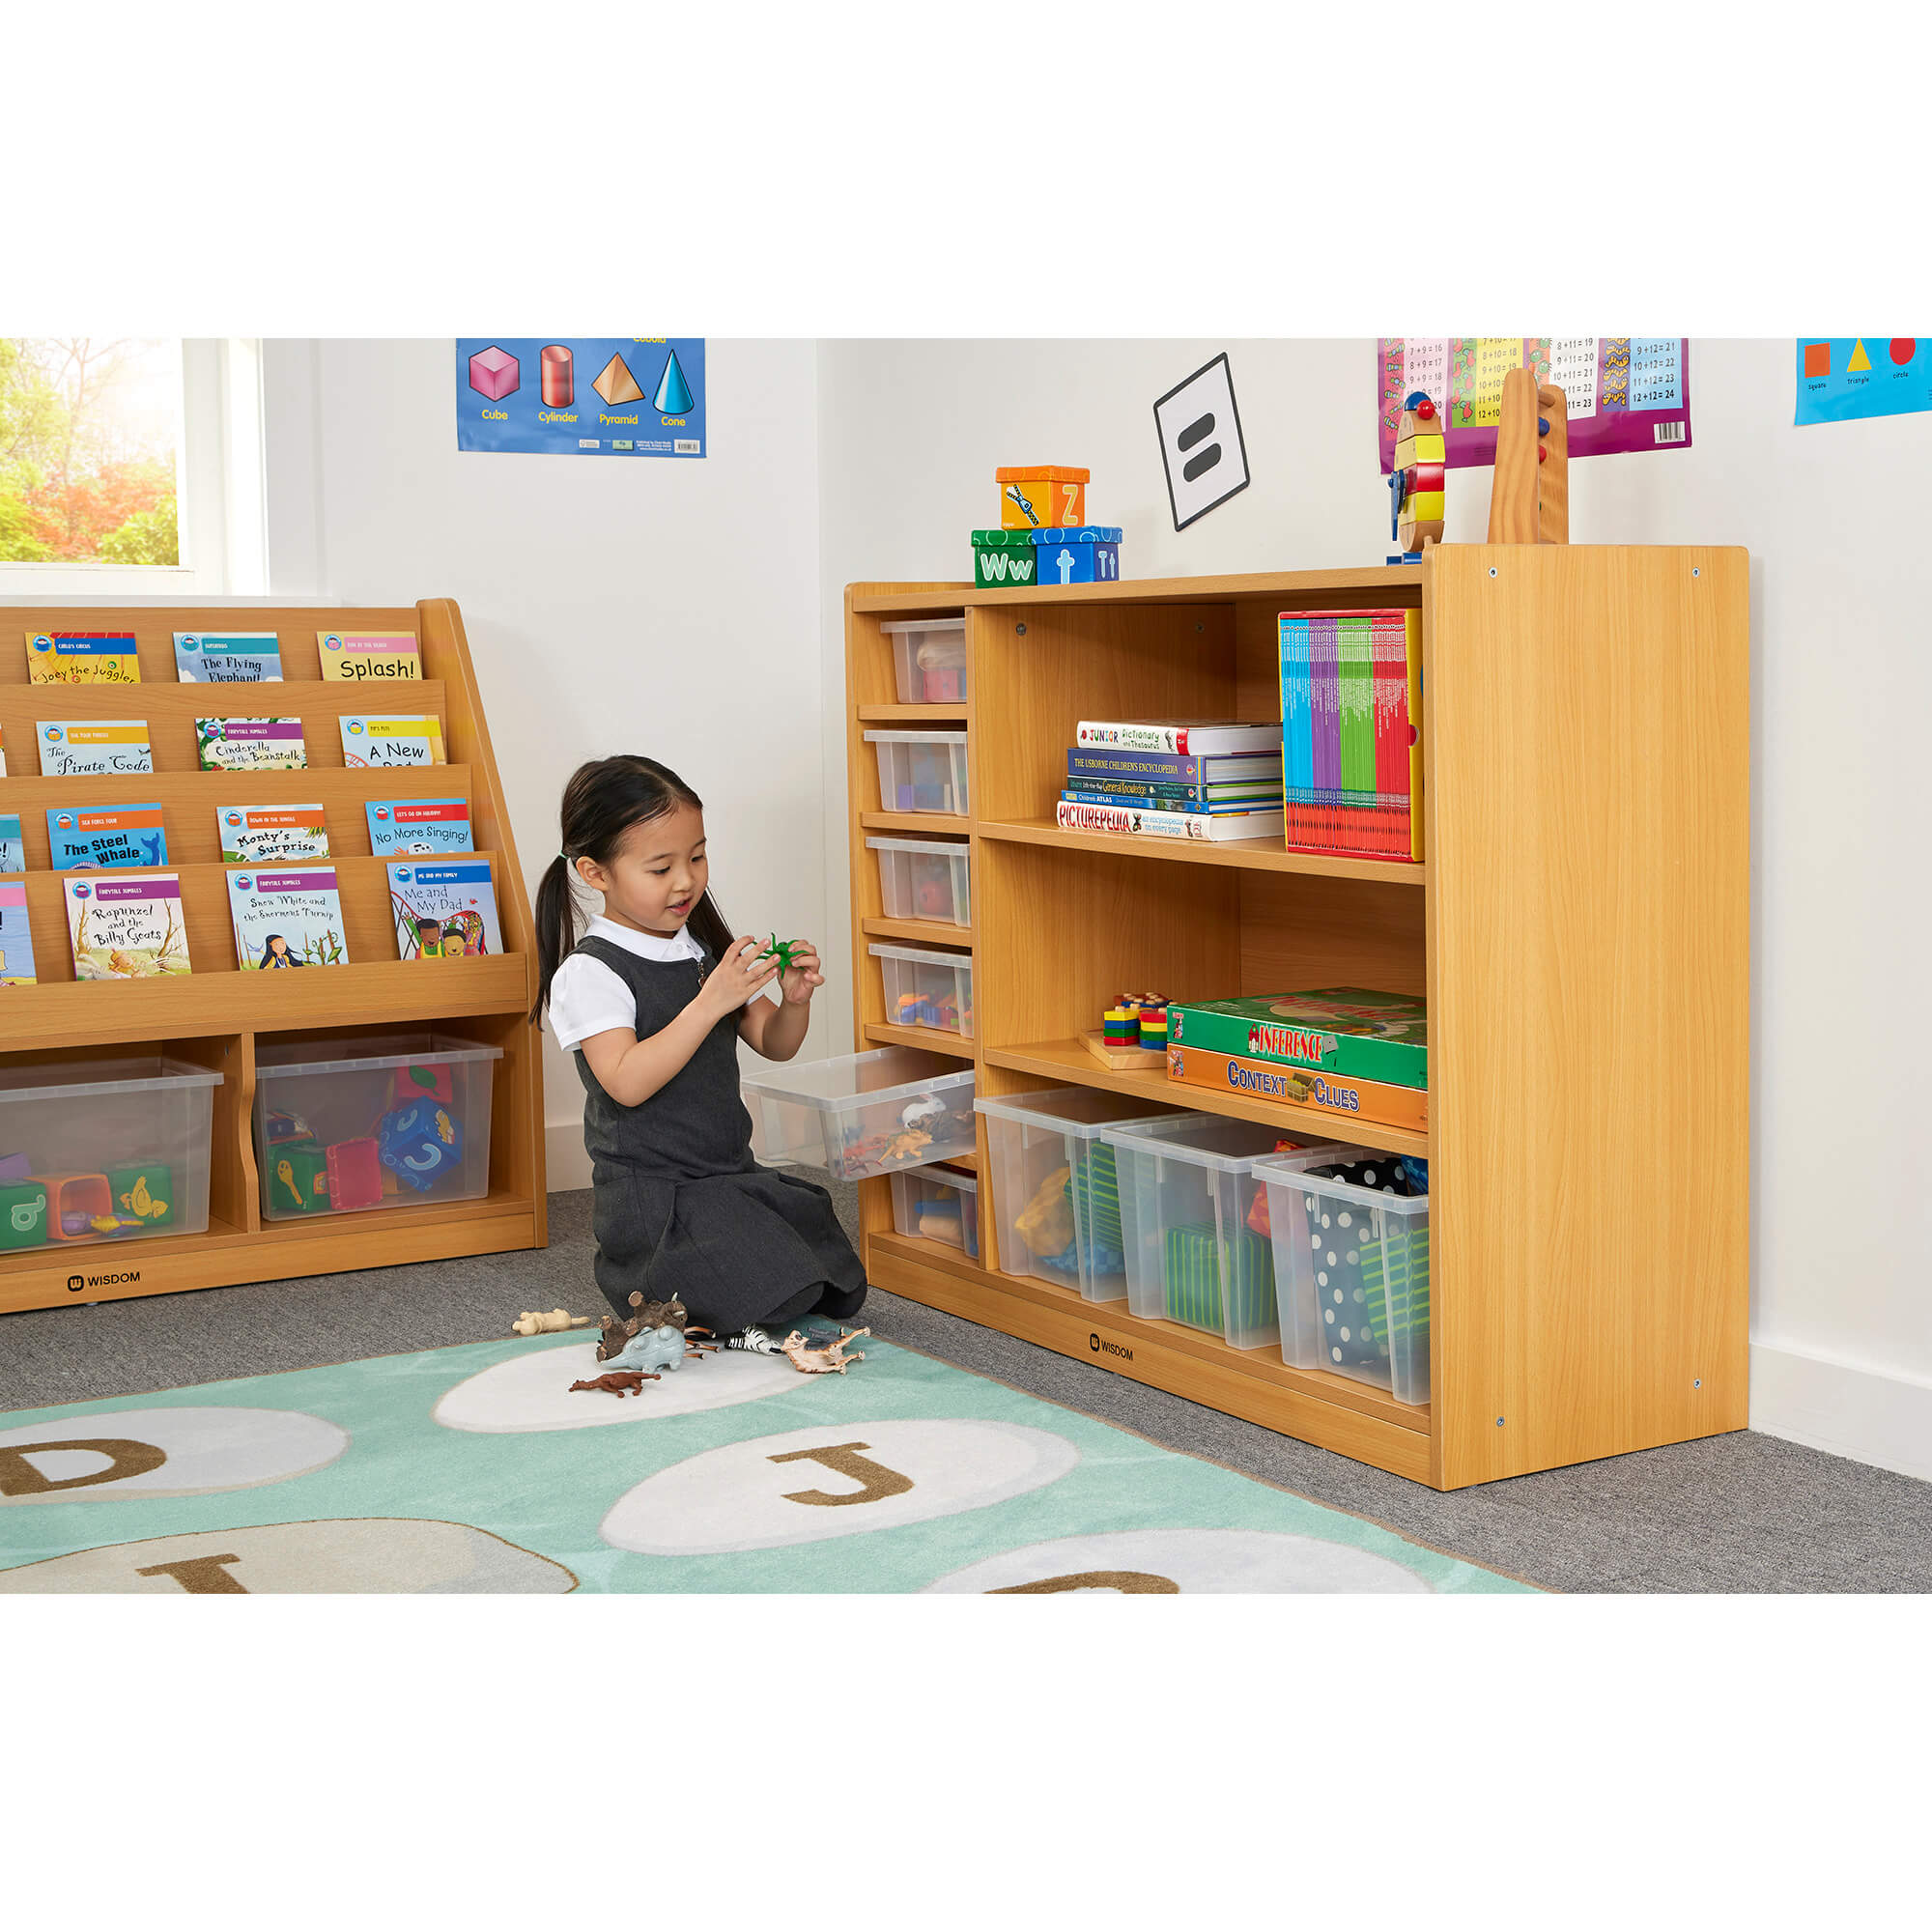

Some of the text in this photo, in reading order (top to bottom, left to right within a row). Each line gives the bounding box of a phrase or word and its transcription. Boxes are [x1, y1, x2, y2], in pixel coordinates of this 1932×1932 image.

[482, 410, 508, 420] Cube
[538, 412, 579, 423] Cylinder
[599, 413, 639, 425] Pyramid
[662, 416, 686, 426] Cone
[1063, 485, 1078, 526] Z
[980, 554, 1033, 581] Ww
[201, 657, 261, 672] The Flying
[341, 658, 413, 680] Splash!
[43, 665, 135, 684] Joey the Juggler
[1090, 729, 1118, 743] JUNIOR
[46, 747, 65, 757] The
[216, 742, 270, 756] Cinderella
[250, 750, 299, 762] Beanstalk
[370, 743, 423, 759] A New
[57, 754, 150, 775] Pirate Code
[1074, 758, 1084, 767] THE
[1085, 759, 1108, 769] USBORNE
[1139, 763, 1178, 774] ENCYCLOPEDIA
[1059, 805, 1132, 833] PICTUREPEDIA
[237, 831, 290, 847] Monty's
[376, 827, 469, 844] No More Singing!
[64, 835, 128, 855] The Steel
[258, 841, 315, 855] Surprise
[96, 847, 139, 864] Whale
[405, 885, 448, 900] Me and
[250, 897, 273, 908] Snow
[277, 896, 307, 905] White
[417, 898, 462, 914] My Dad
[92, 904, 153, 921] Rapunzel
[259, 910, 299, 919] Enormous
[301, 908, 333, 920] Turnip
[108, 919, 125, 929] and
[94, 927, 161, 946] Billy Goats
[1259, 1026, 1321, 1063] INFERENCE
[1228, 1061, 1359, 1112] CONTEXT CLUES
[88, 1272, 140, 1286] WISDOM
[1101, 1340, 1133, 1360] WISDOM
[0, 1438, 167, 1496] D
[765, 1441, 915, 1507] J
